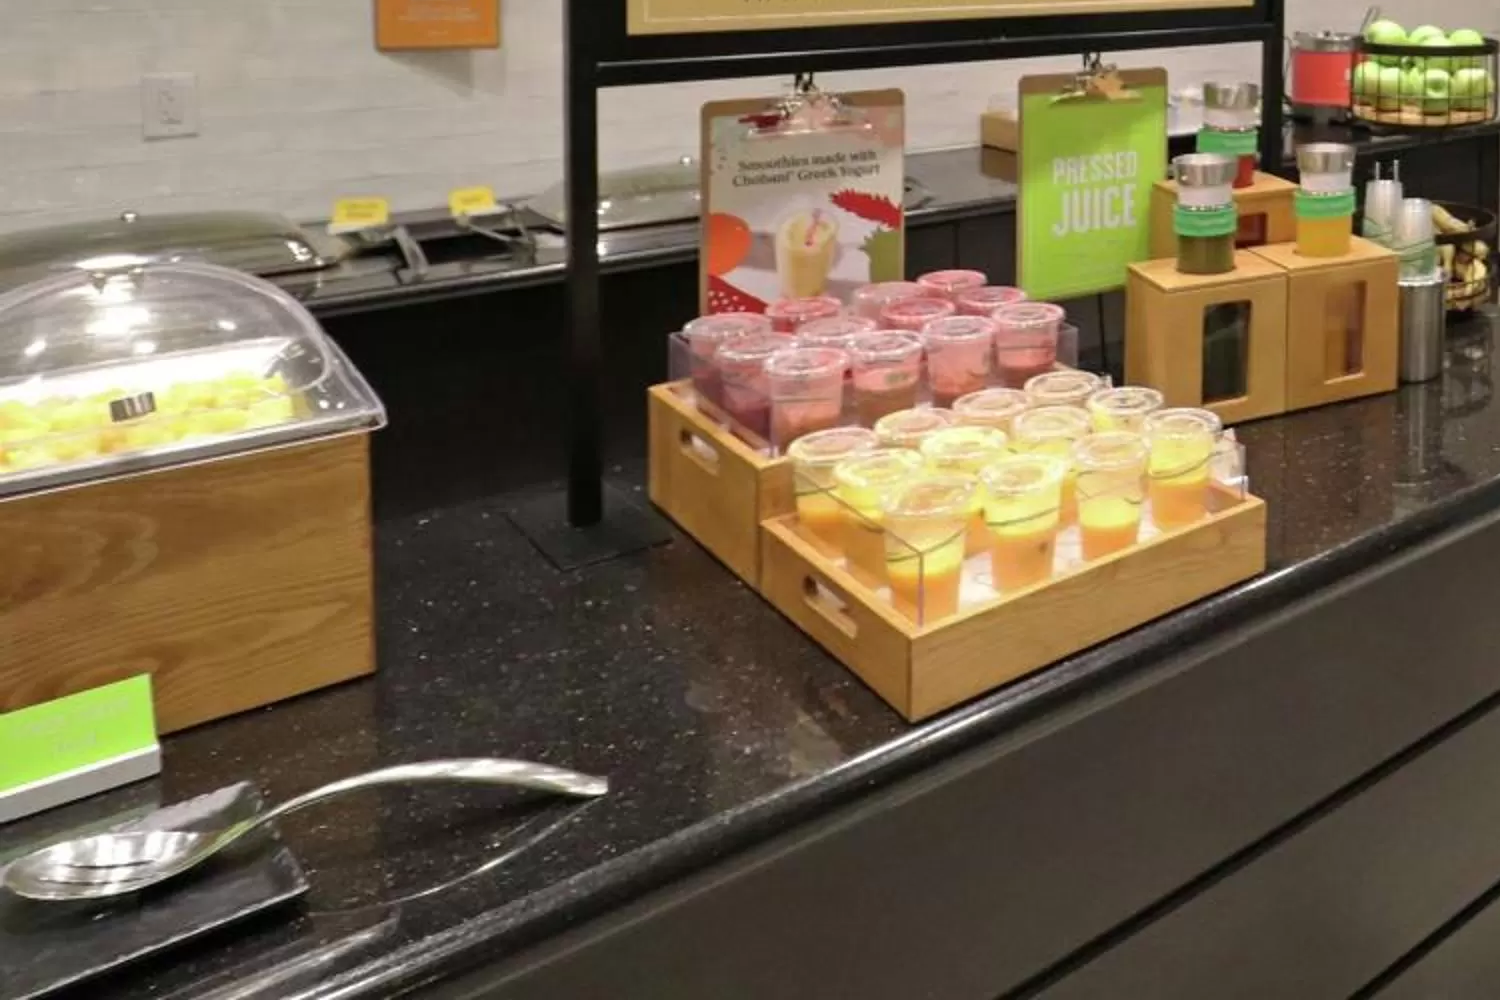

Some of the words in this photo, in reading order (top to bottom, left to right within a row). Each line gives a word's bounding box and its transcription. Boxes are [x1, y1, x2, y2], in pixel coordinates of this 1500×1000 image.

[737, 154, 809, 171] Smoothies
[811, 152, 846, 165] made
[850, 149, 877, 161] with
[798, 166, 838, 181] Greek
[839, 164, 881, 178] Yogurt
[1052, 151, 1138, 185] PRESSED
[1053, 183, 1137, 238] JUICE
